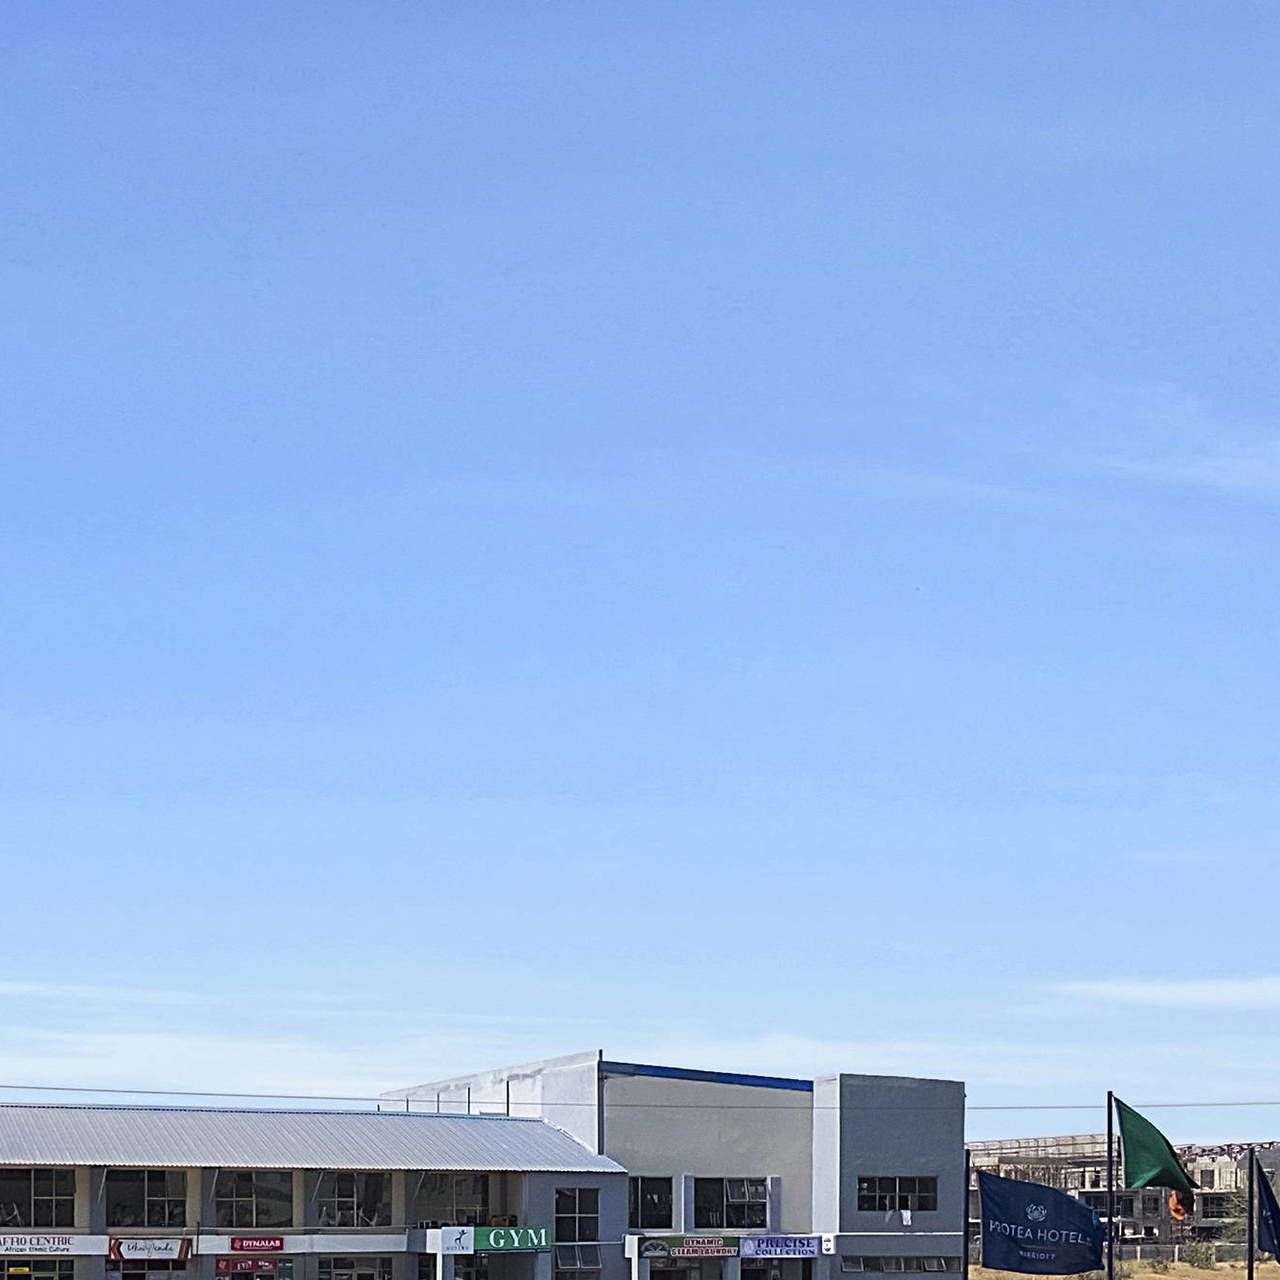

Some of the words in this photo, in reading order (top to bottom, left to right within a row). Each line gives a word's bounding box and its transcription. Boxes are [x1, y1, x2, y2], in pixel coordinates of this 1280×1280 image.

[989, 1220, 1033, 1240] PROTEA
[29, 1236, 75, 1246] CENTRIC
[489, 1228, 547, 1248] GYM
[684, 1238, 723, 1247] DYNAMIC
[757, 1238, 815, 1248] PRECISE
[755, 1248, 816, 1256] COLLECTION
